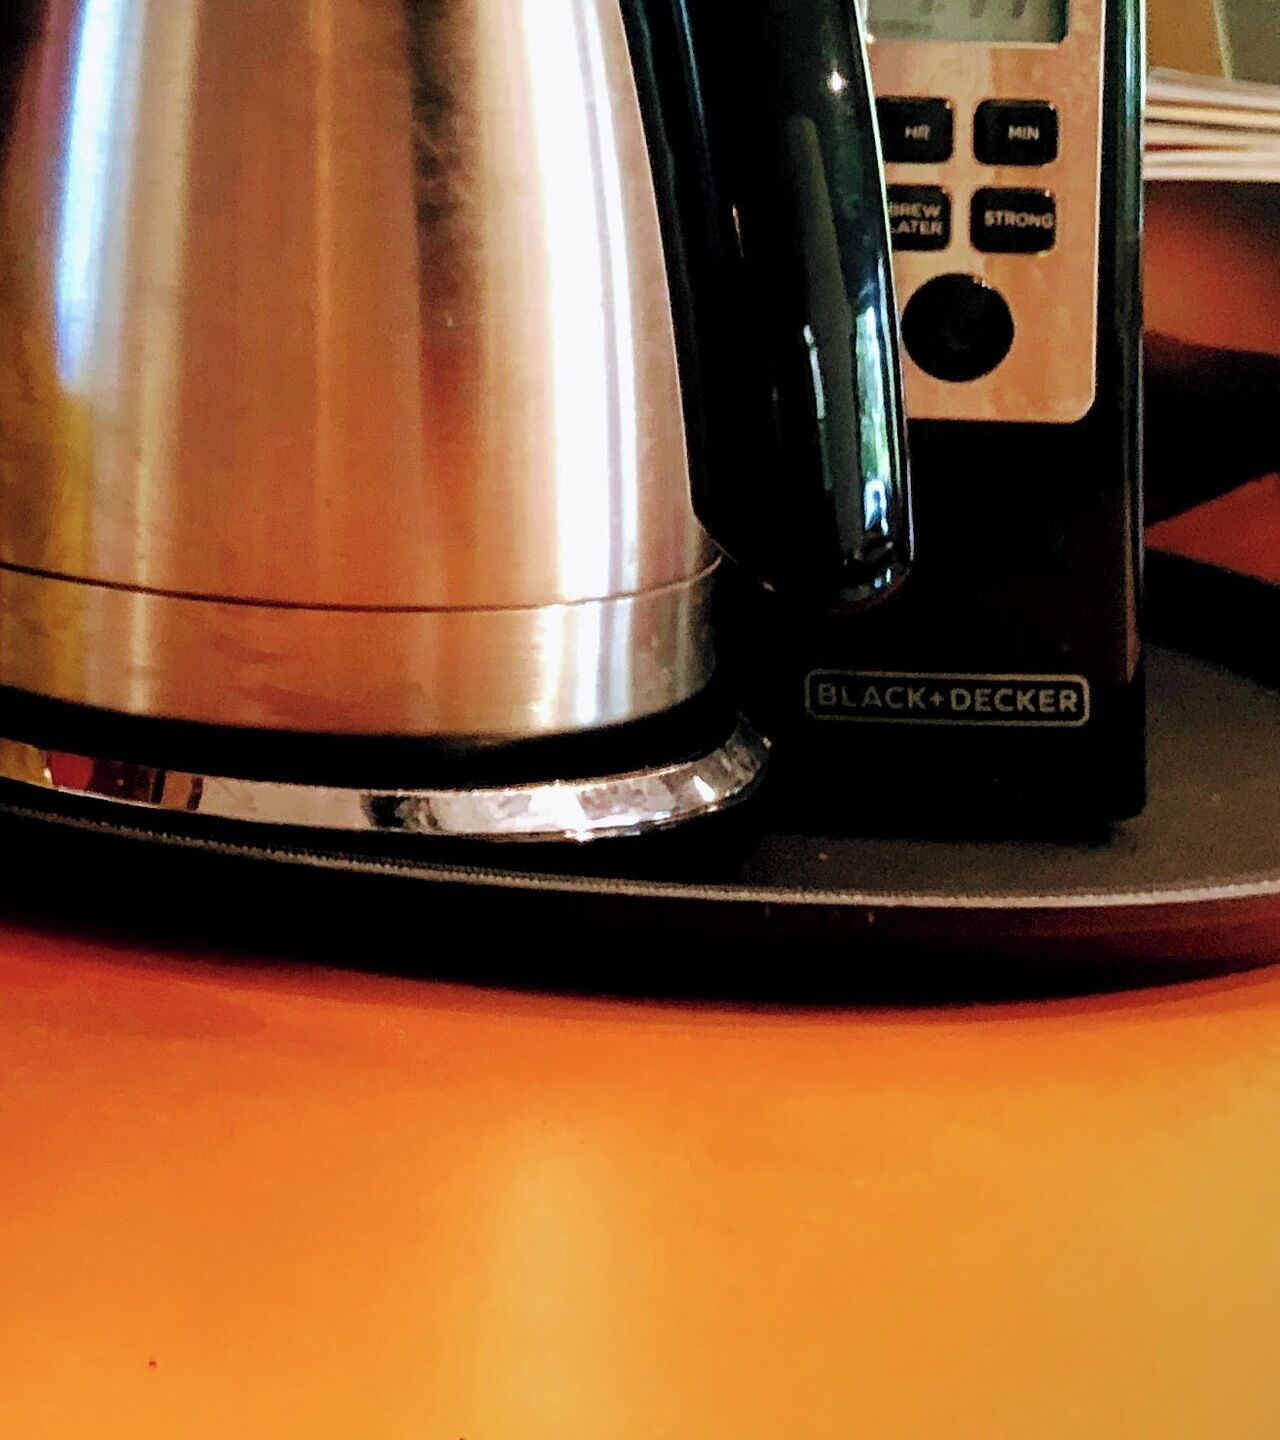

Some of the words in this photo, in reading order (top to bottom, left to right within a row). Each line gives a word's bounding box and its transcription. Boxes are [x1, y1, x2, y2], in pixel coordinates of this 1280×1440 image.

[904, 124, 931, 142] HR
[1007, 124, 1040, 142] MIN
[983, 210, 1055, 229] STRONG
[817, 683, 1079, 713] BLACK+DECKER
